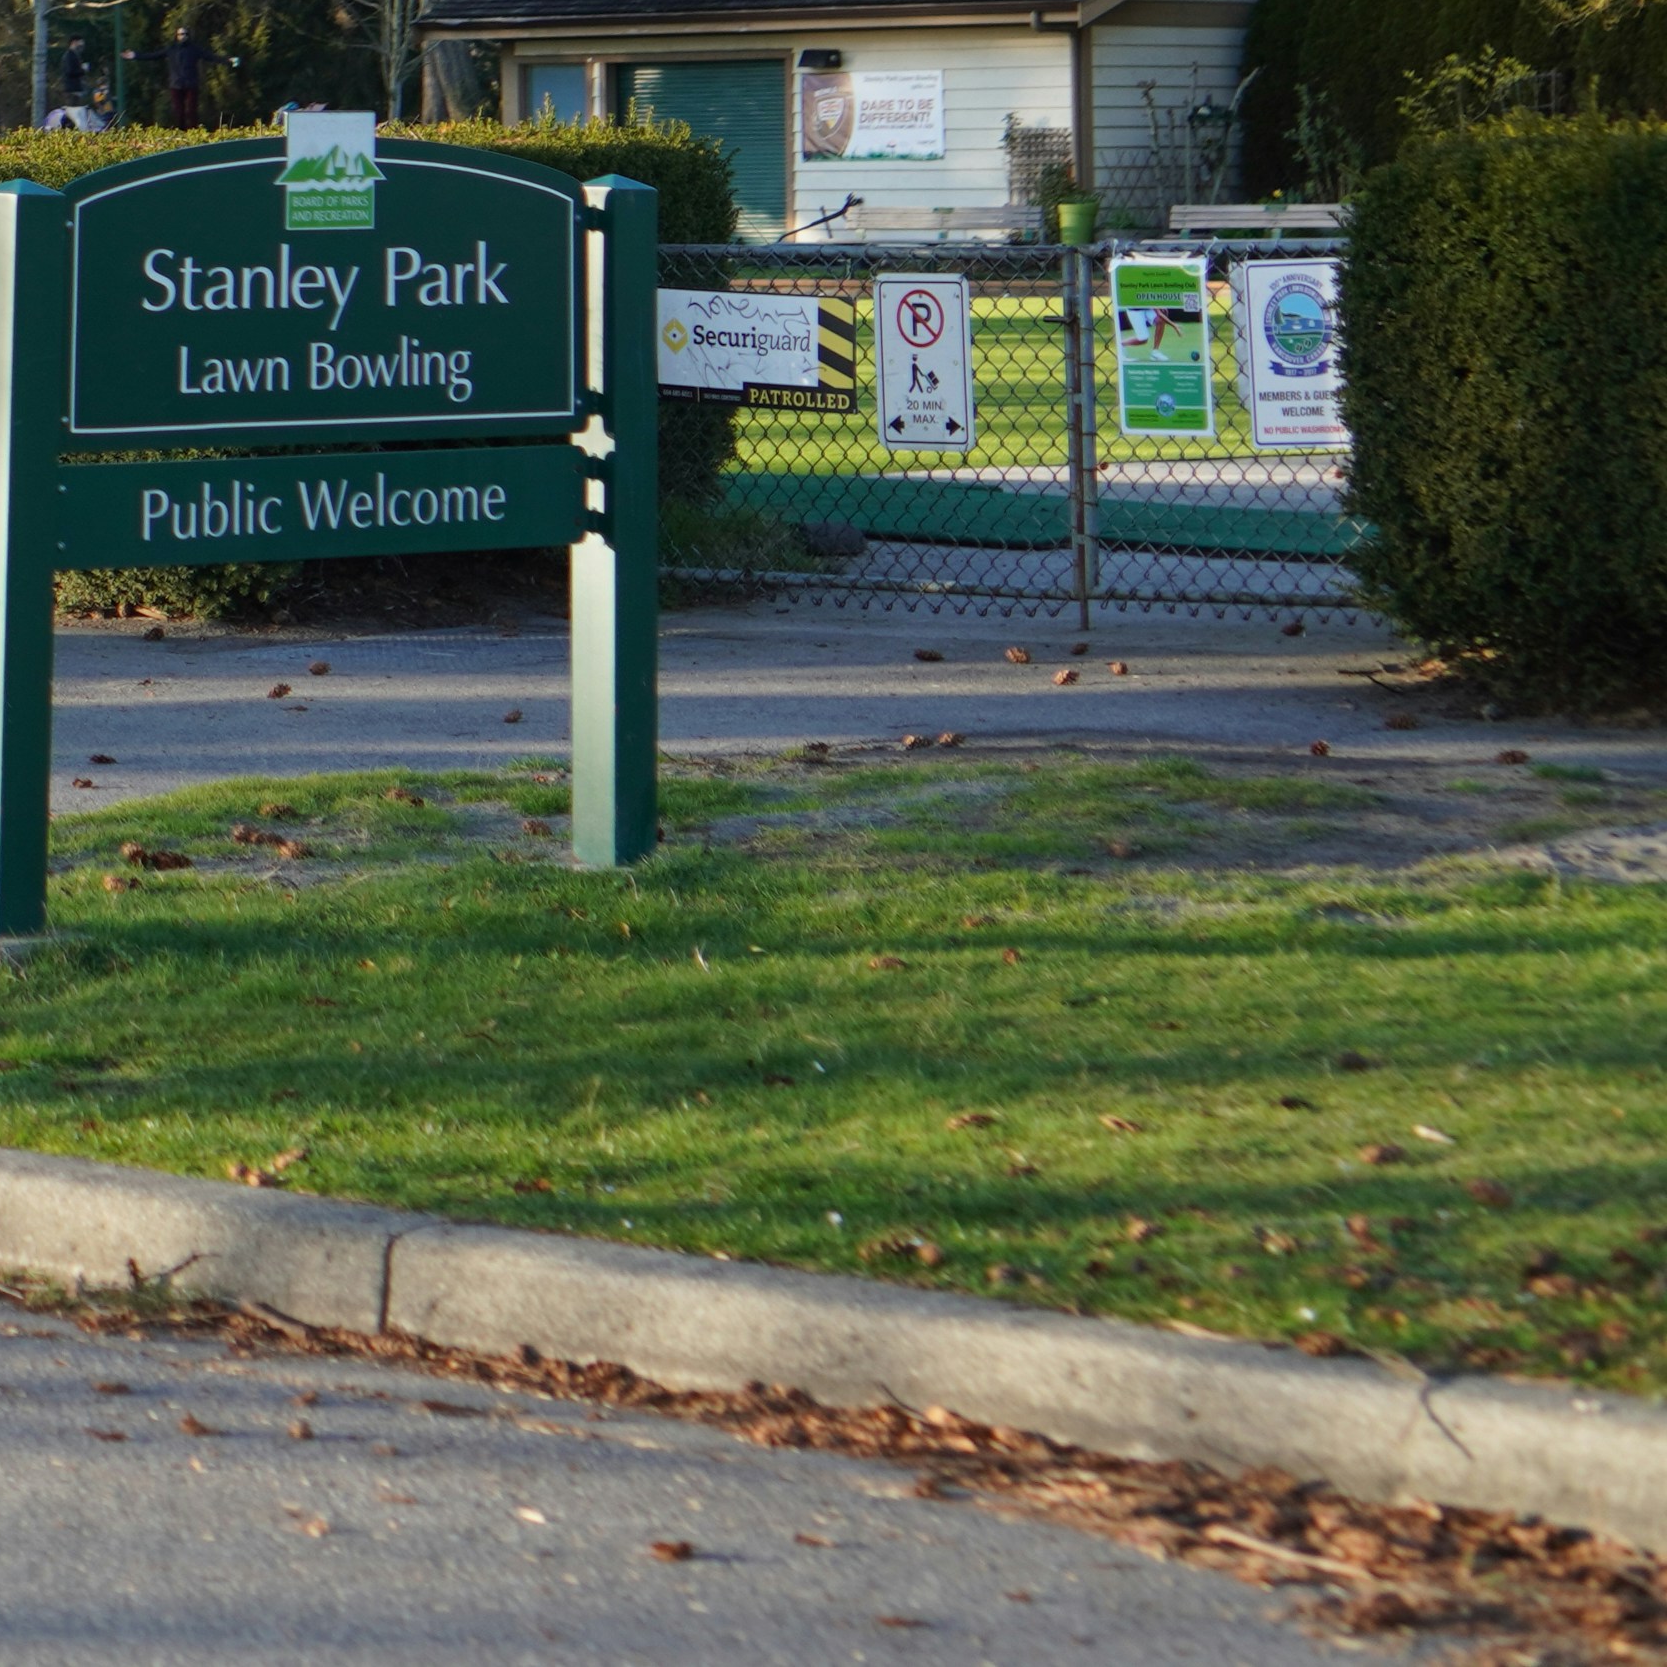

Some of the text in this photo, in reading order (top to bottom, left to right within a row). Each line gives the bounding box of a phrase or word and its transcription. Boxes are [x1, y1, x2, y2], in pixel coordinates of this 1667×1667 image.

[861, 98, 934, 111] DARE TO BE
[859, 111, 931, 124] DIFFERENT!
[292, 196, 369, 207] BOARD OF PARKS
[292, 210, 369, 221] AND RECREATION
[141, 240, 510, 332] Stanley Park
[1282, 273, 1324, 290] ANNIVERSARY
[693, 324, 811, 356] Securiguard
[178, 335, 473, 403] Lawn Bowling
[749, 388, 851, 410] PATROLLED
[1259, 391, 1302, 401] MEMBERS
[1304, 390, 1311, 401] &
[907, 400, 944, 410] 20 MIN.
[1282, 406, 1325, 416] WELCOME
[913, 414, 939, 424] MAX.
[1275, 426, 1299, 434] PUBLIC
[142, 472, 507, 541] Public Welcome
